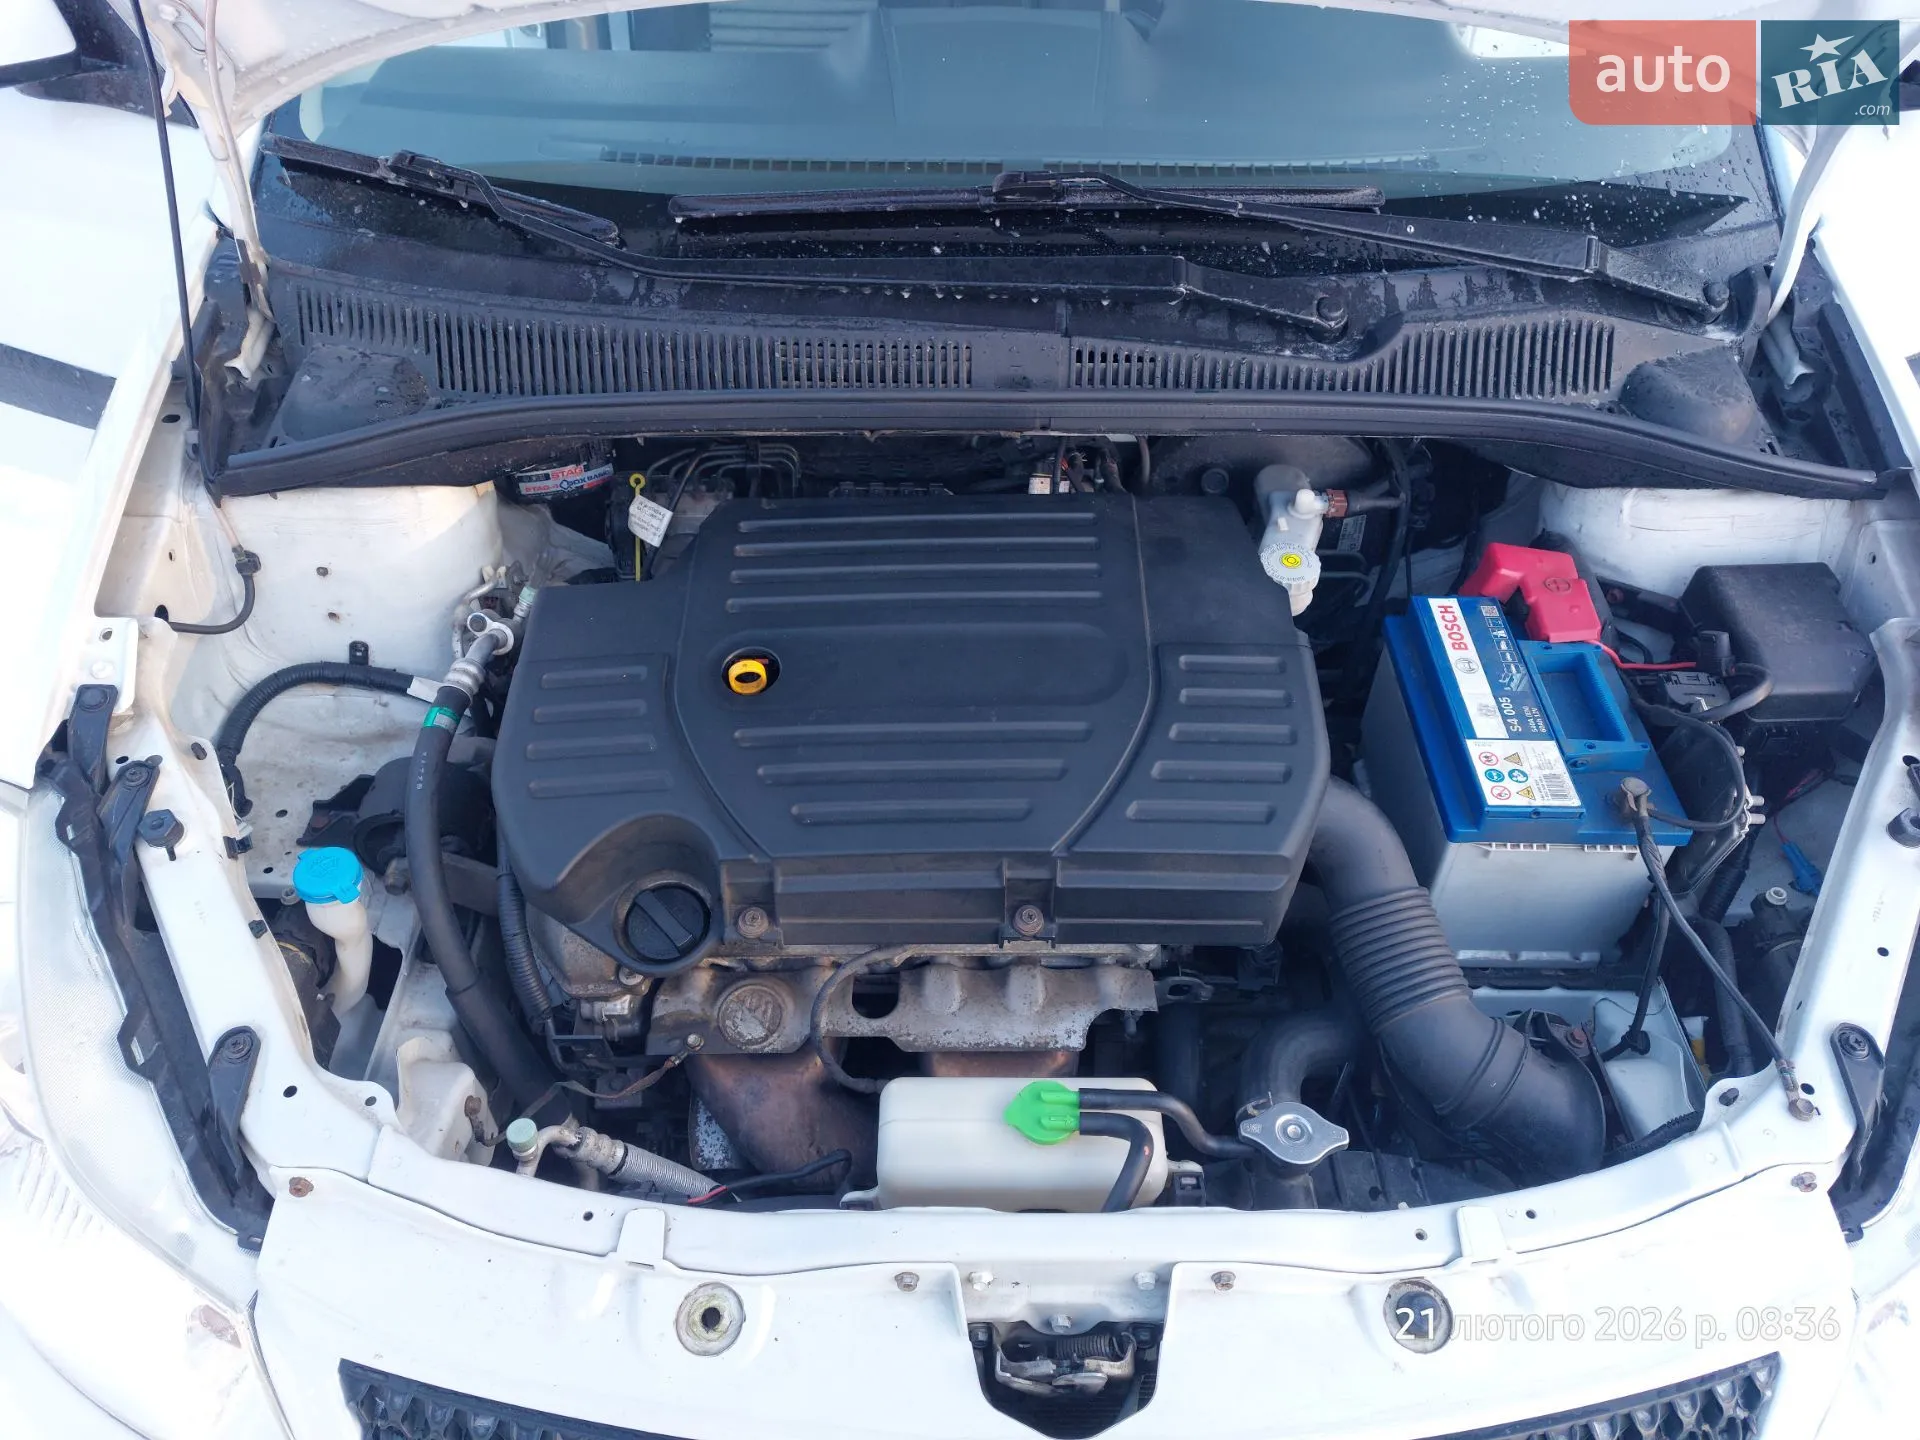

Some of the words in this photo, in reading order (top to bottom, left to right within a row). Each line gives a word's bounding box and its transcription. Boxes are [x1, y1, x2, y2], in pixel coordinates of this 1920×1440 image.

[551, 466, 583, 479] STAG
[1438, 605, 1468, 650] BOSCH
[1498, 696, 1516, 716] 005
[1506, 718, 1522, 732] S4
